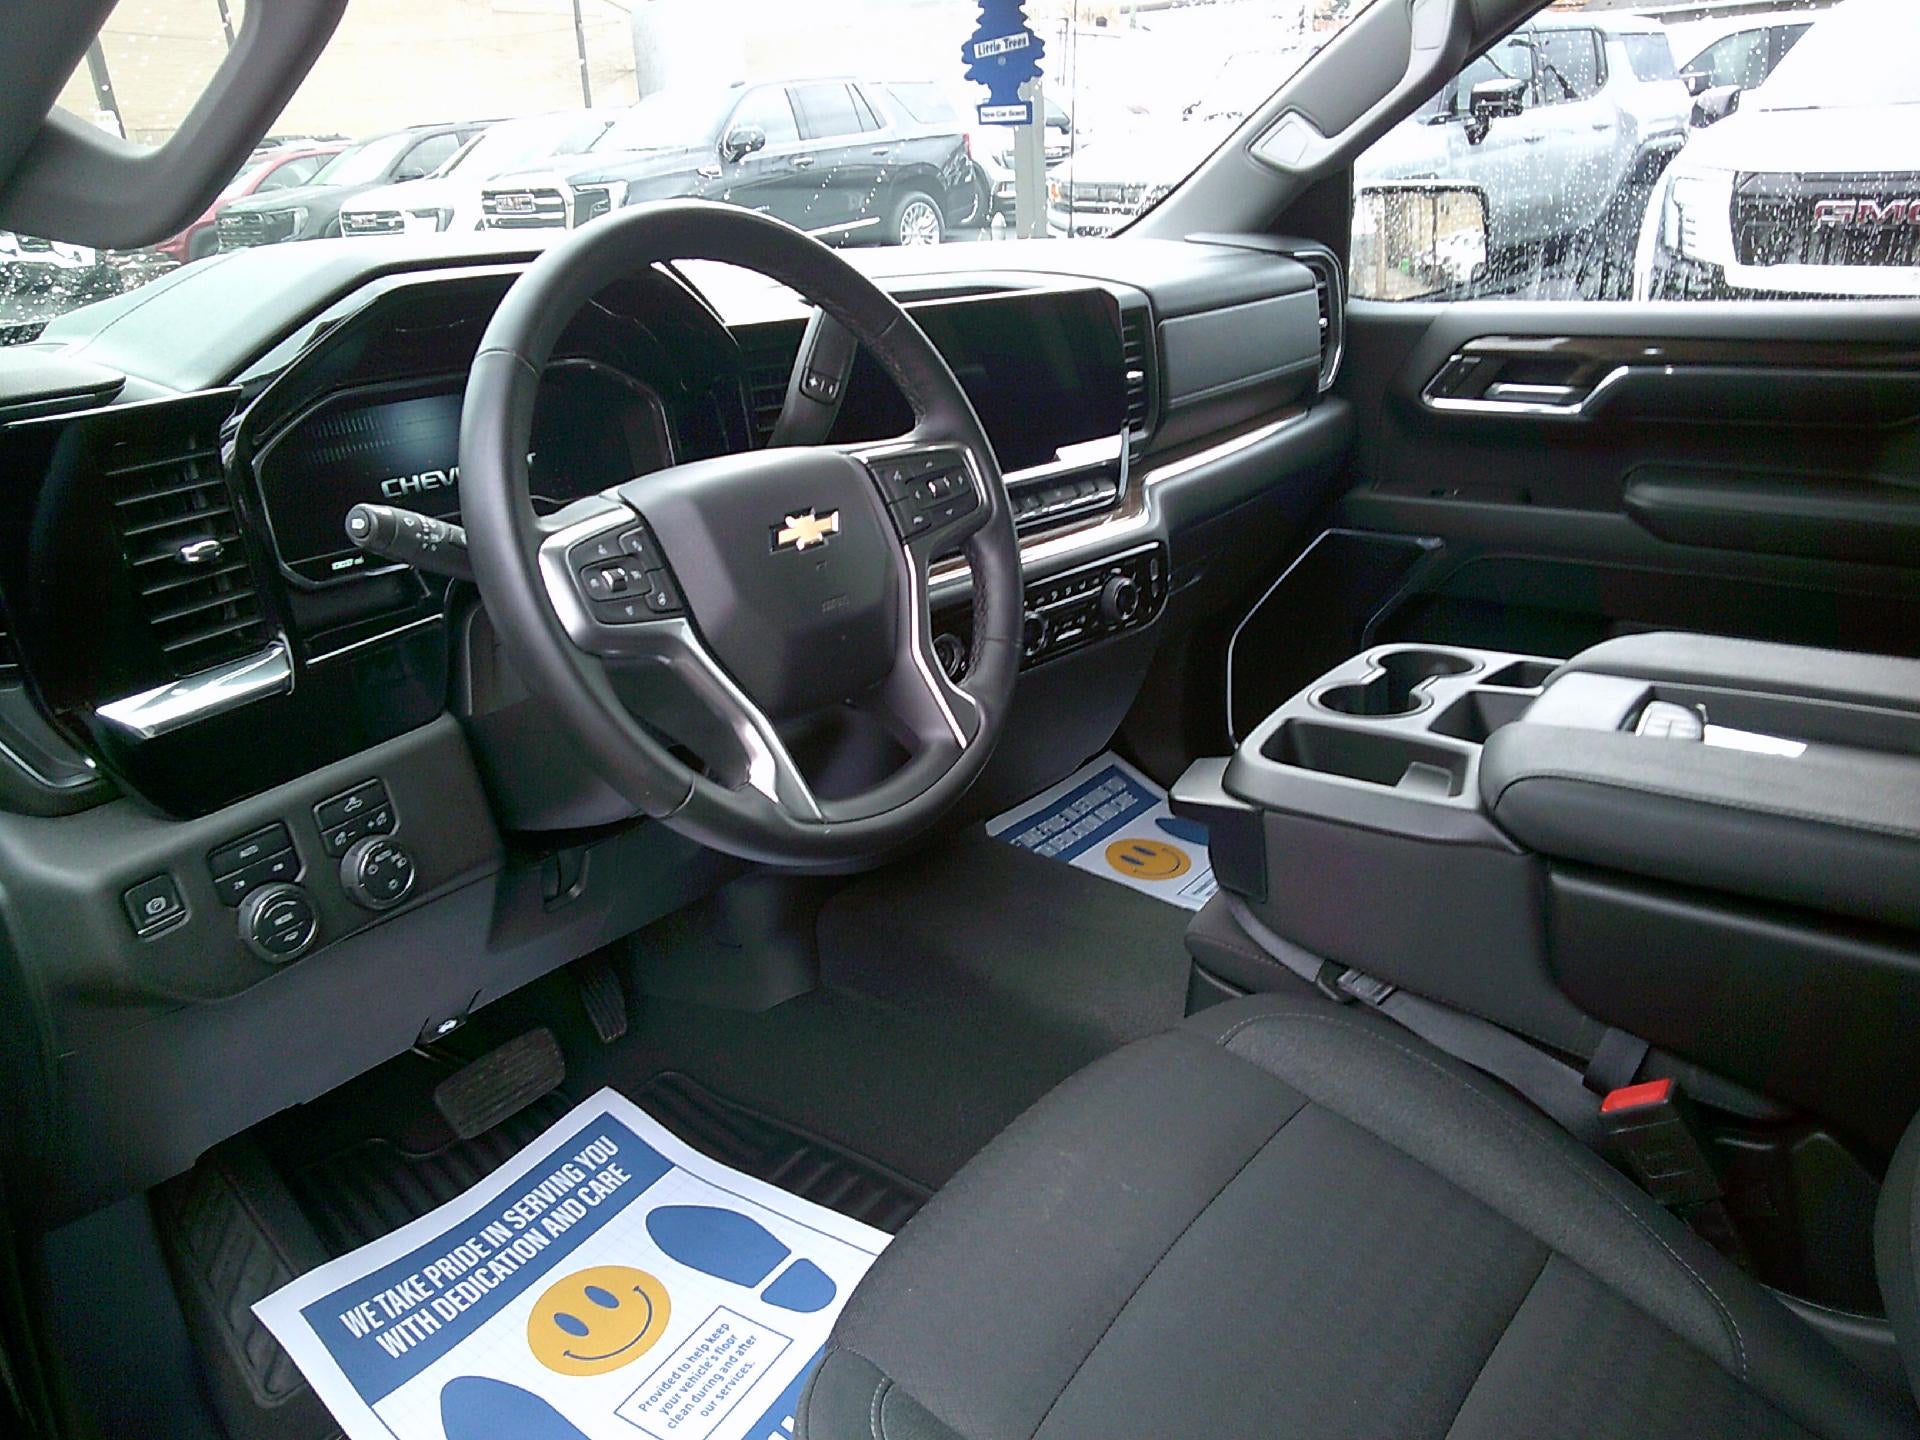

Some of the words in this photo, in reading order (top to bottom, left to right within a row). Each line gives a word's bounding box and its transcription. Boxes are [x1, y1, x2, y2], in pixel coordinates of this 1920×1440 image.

[977, 42, 1001, 56] Little
[1813, 199, 1920, 225] GM
[338, 1301, 385, 1339] WE
[373, 1273, 435, 1319] TAKE
[422, 1237, 492, 1289] PRIDE
[479, 1220, 513, 1248] IN
[502, 1163, 586, 1230] SERVING
[573, 1135, 619, 1171] YOU
[375, 1308, 442, 1359] WITH
[430, 1227, 551, 1322] DEDICATION
[540, 1198, 587, 1239] AND
[577, 1162, 632, 1206] CARE
[638, 1371, 681, 1412] Provided
[677, 1363, 692, 1373] to
[685, 1343, 710, 1363] help
[705, 1323, 731, 1344] keep
[659, 1393, 682, 1415] your
[680, 1355, 719, 1393] vehicle's
[714, 1334, 738, 1355] floor
[667, 1403, 695, 1429] clean
[691, 1373, 725, 1403] during
[719, 1355, 738, 1373] and
[735, 1334, 758, 1356] after
[700, 1400, 718, 1417] our
[716, 1361, 756, 1400] services.
